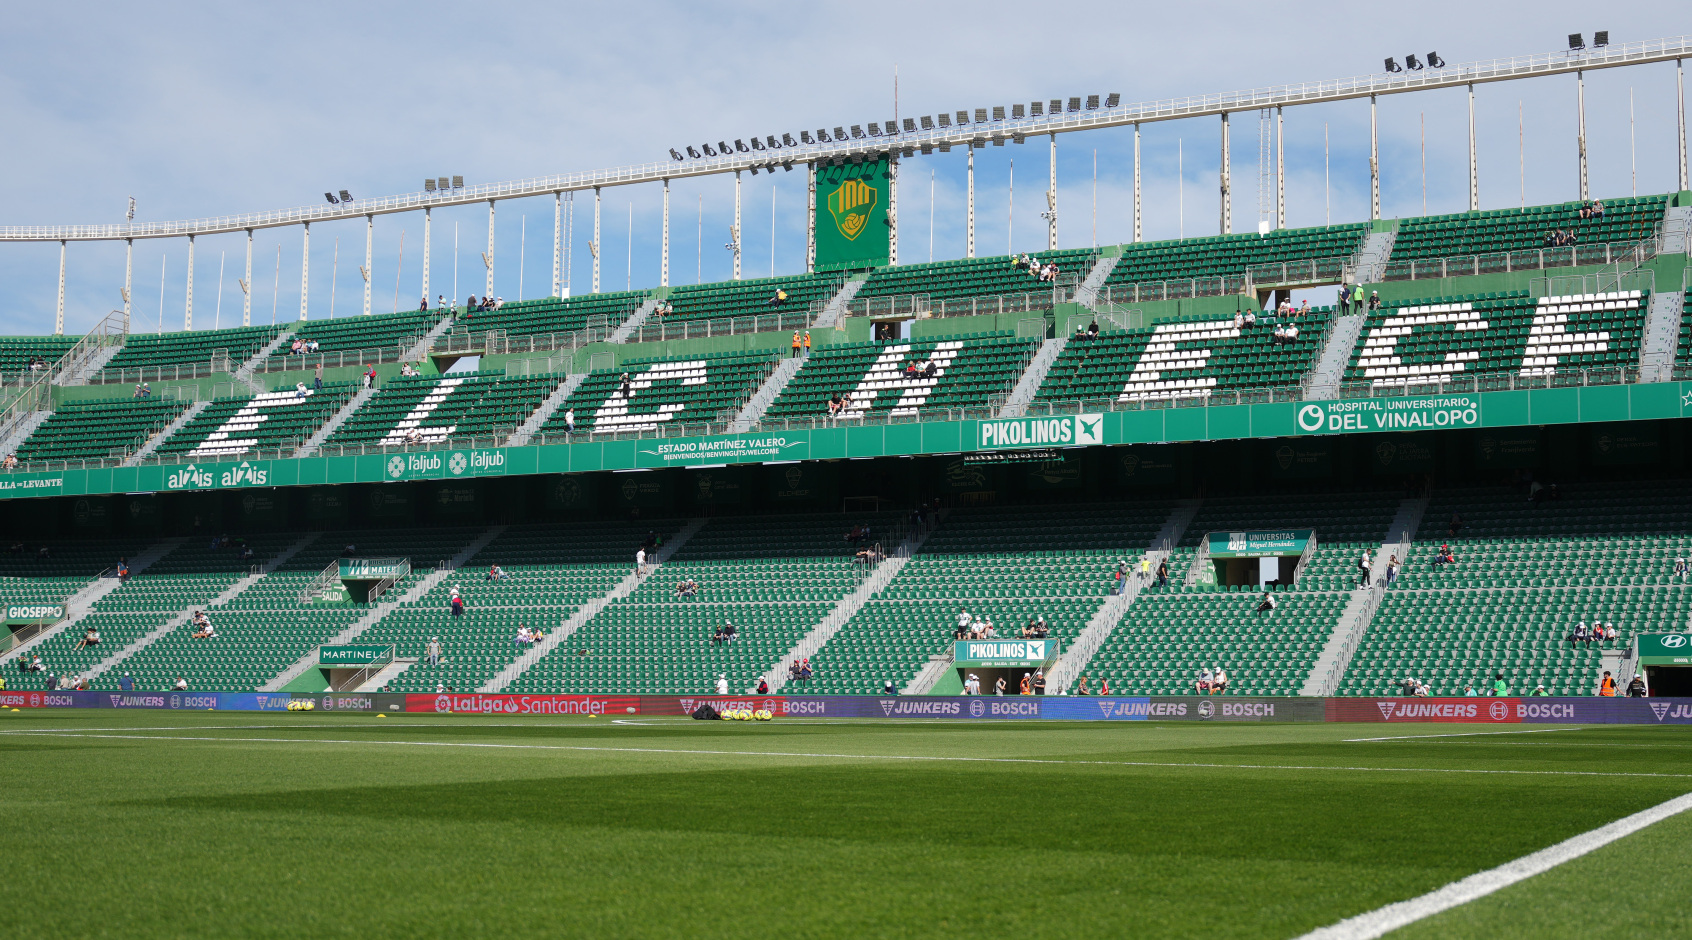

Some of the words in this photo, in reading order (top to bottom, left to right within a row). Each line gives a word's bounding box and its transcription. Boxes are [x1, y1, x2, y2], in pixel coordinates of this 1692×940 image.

[1328, 401, 1383, 413] HOSPITAL
[1387, 397, 1469, 410] UNIVERSITARIO
[1329, 413, 1368, 431] DEL
[982, 418, 1072, 446] PIKOLINOS
[658, 443, 696, 454] ESTADIO
[699, 438, 746, 451] MARTÍNEZ
[748, 437, 786, 448] VALERO
[23, 478, 63, 488] LEVANTE
[1249, 532, 1295, 541] UNIVERSITAS
[1249, 541, 1268, 549] Miguel
[321, 591, 343, 602] SALIDA
[9, 606, 63, 618] GIOSEPPO
[323, 650, 389, 659] MARTINELLI
[969, 643, 1025, 658] PIKOLINOS
[0, 695, 24, 705] KERS
[44, 695, 73, 706] BOSCH
[119, 696, 164, 707] JUNKERS
[185, 697, 216, 707] BOSCH
[338, 698, 372, 709] BOSCH
[453, 695, 502, 713] LaLiga
[521, 696, 608, 714] Santander
[782, 701, 825, 714] BOSCH
[894, 701, 960, 714] JUNKERS
[991, 702, 1038, 715] BOSCH
[1114, 702, 1187, 716] JUNKERS
[1222, 703, 1275, 717] BOSCH
[1395, 703, 1477, 717] JUNKERS
[1516, 704, 1575, 718] BOSCH
